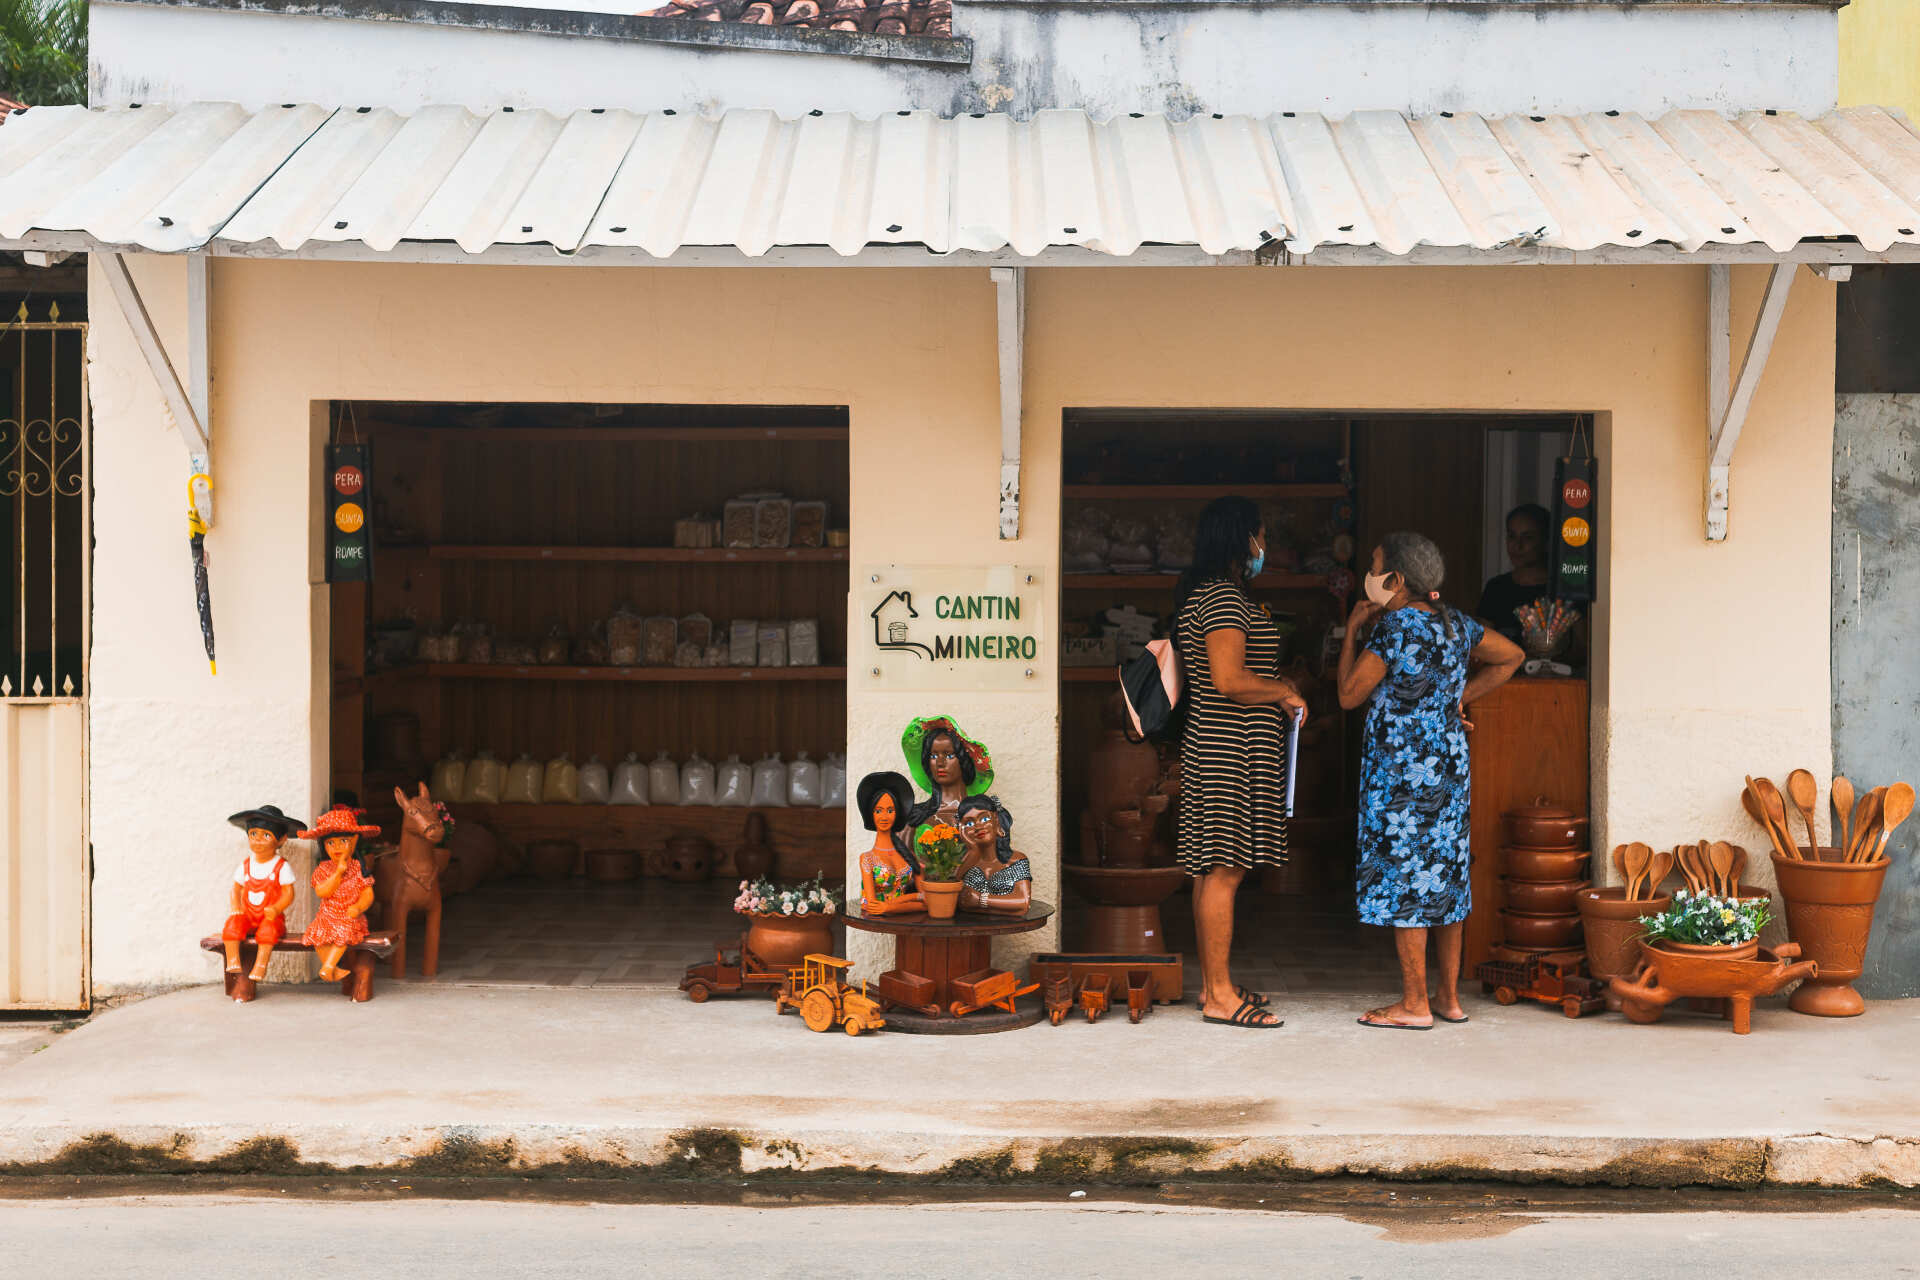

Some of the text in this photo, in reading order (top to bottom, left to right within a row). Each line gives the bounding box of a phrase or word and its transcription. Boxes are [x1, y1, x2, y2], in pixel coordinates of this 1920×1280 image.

[335, 473, 361, 487] PERA
[1565, 488, 1588, 499] PERA
[1563, 527, 1588, 538] SUNTA
[335, 545, 364, 560] ROMPE
[1562, 563, 1588, 576] ROMPE
[935, 595, 1020, 620] CANTIN
[934, 635, 1037, 660] MINEIRO
